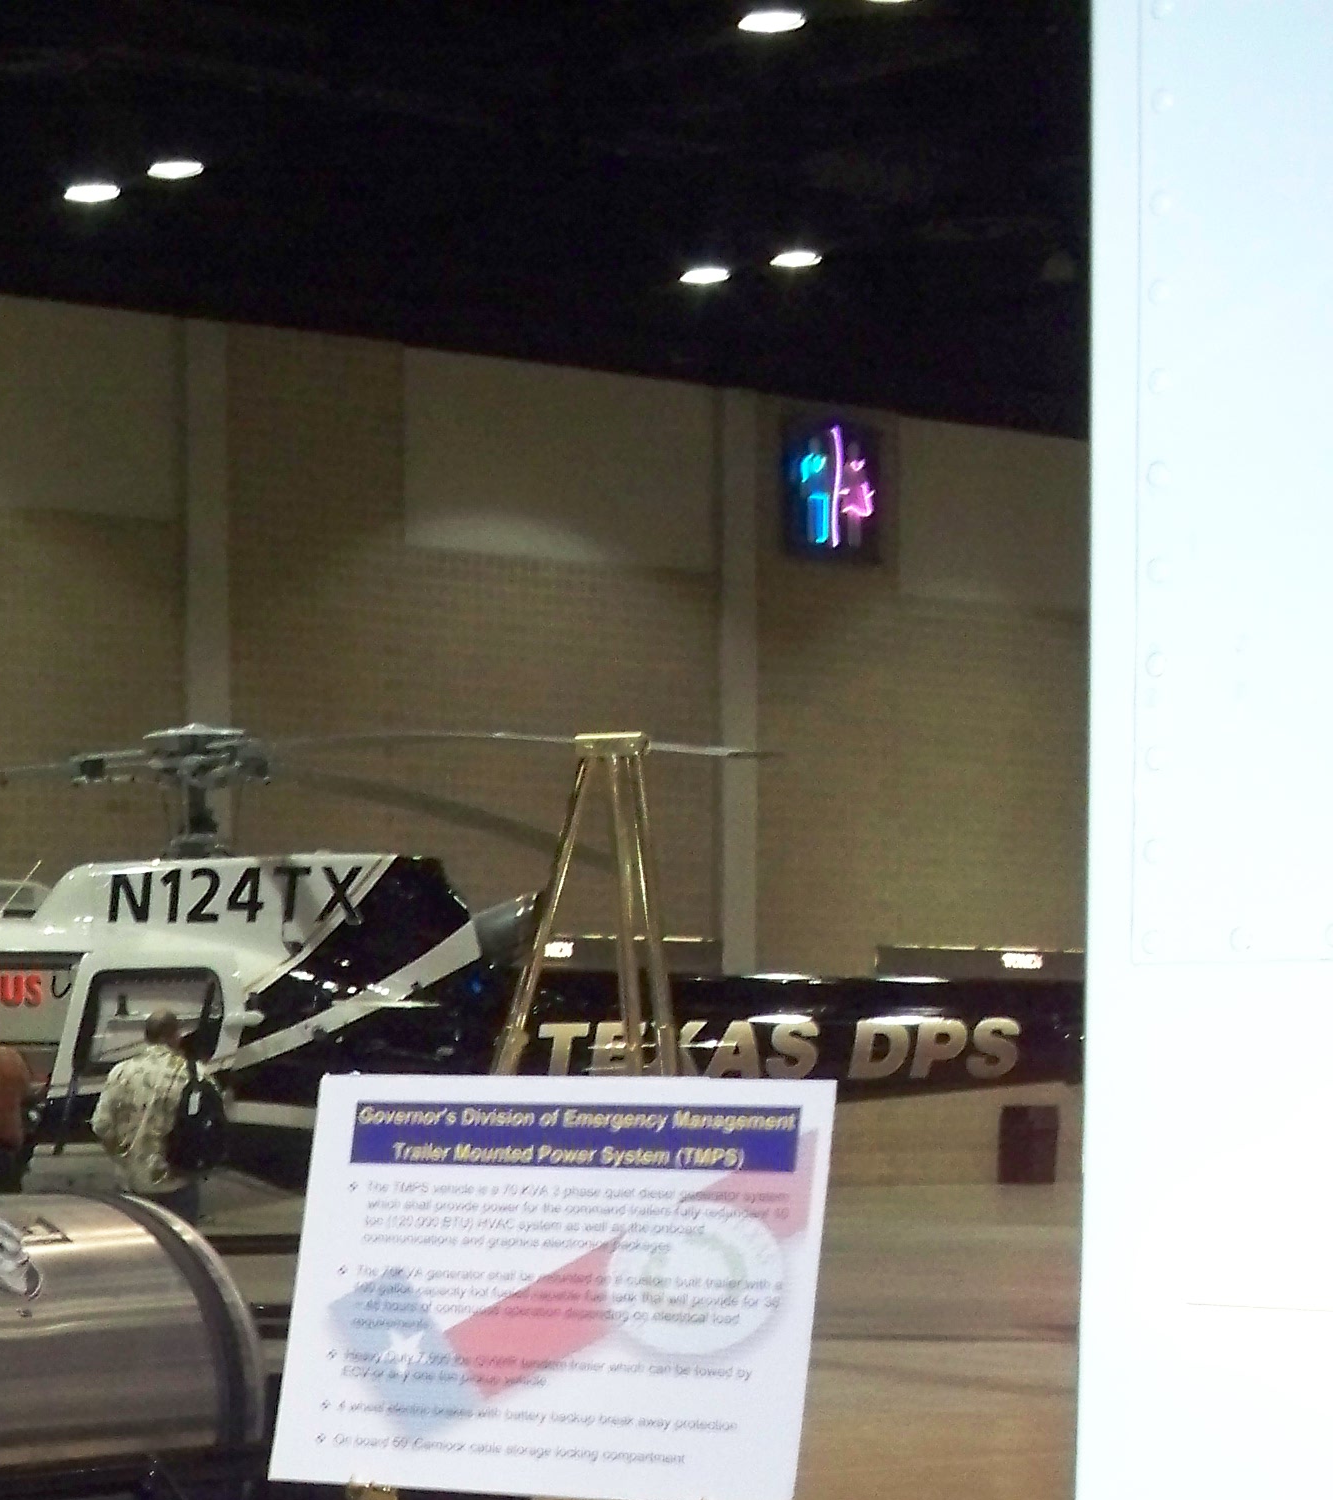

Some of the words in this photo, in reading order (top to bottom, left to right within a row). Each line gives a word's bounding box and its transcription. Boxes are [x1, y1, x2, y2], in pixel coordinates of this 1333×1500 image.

[107, 863, 364, 925] N124TX
[846, 1017, 1023, 1080] DPS
[358, 1106, 457, 1126] Governor's
[461, 1107, 535, 1127] Division
[539, 1108, 561, 1127] of
[562, 1108, 669, 1133] Emergency
[672, 1108, 797, 1134] Management
[392, 1141, 452, 1161] Trailer
[453, 1142, 535, 1163] Mounted
[537, 1144, 598, 1164] Power
[600, 1146, 671, 1167] System
[675, 1146, 745, 1171] (TMPS)
[367, 1180, 389, 1193] The
[394, 1181, 430, 1194] TMPS
